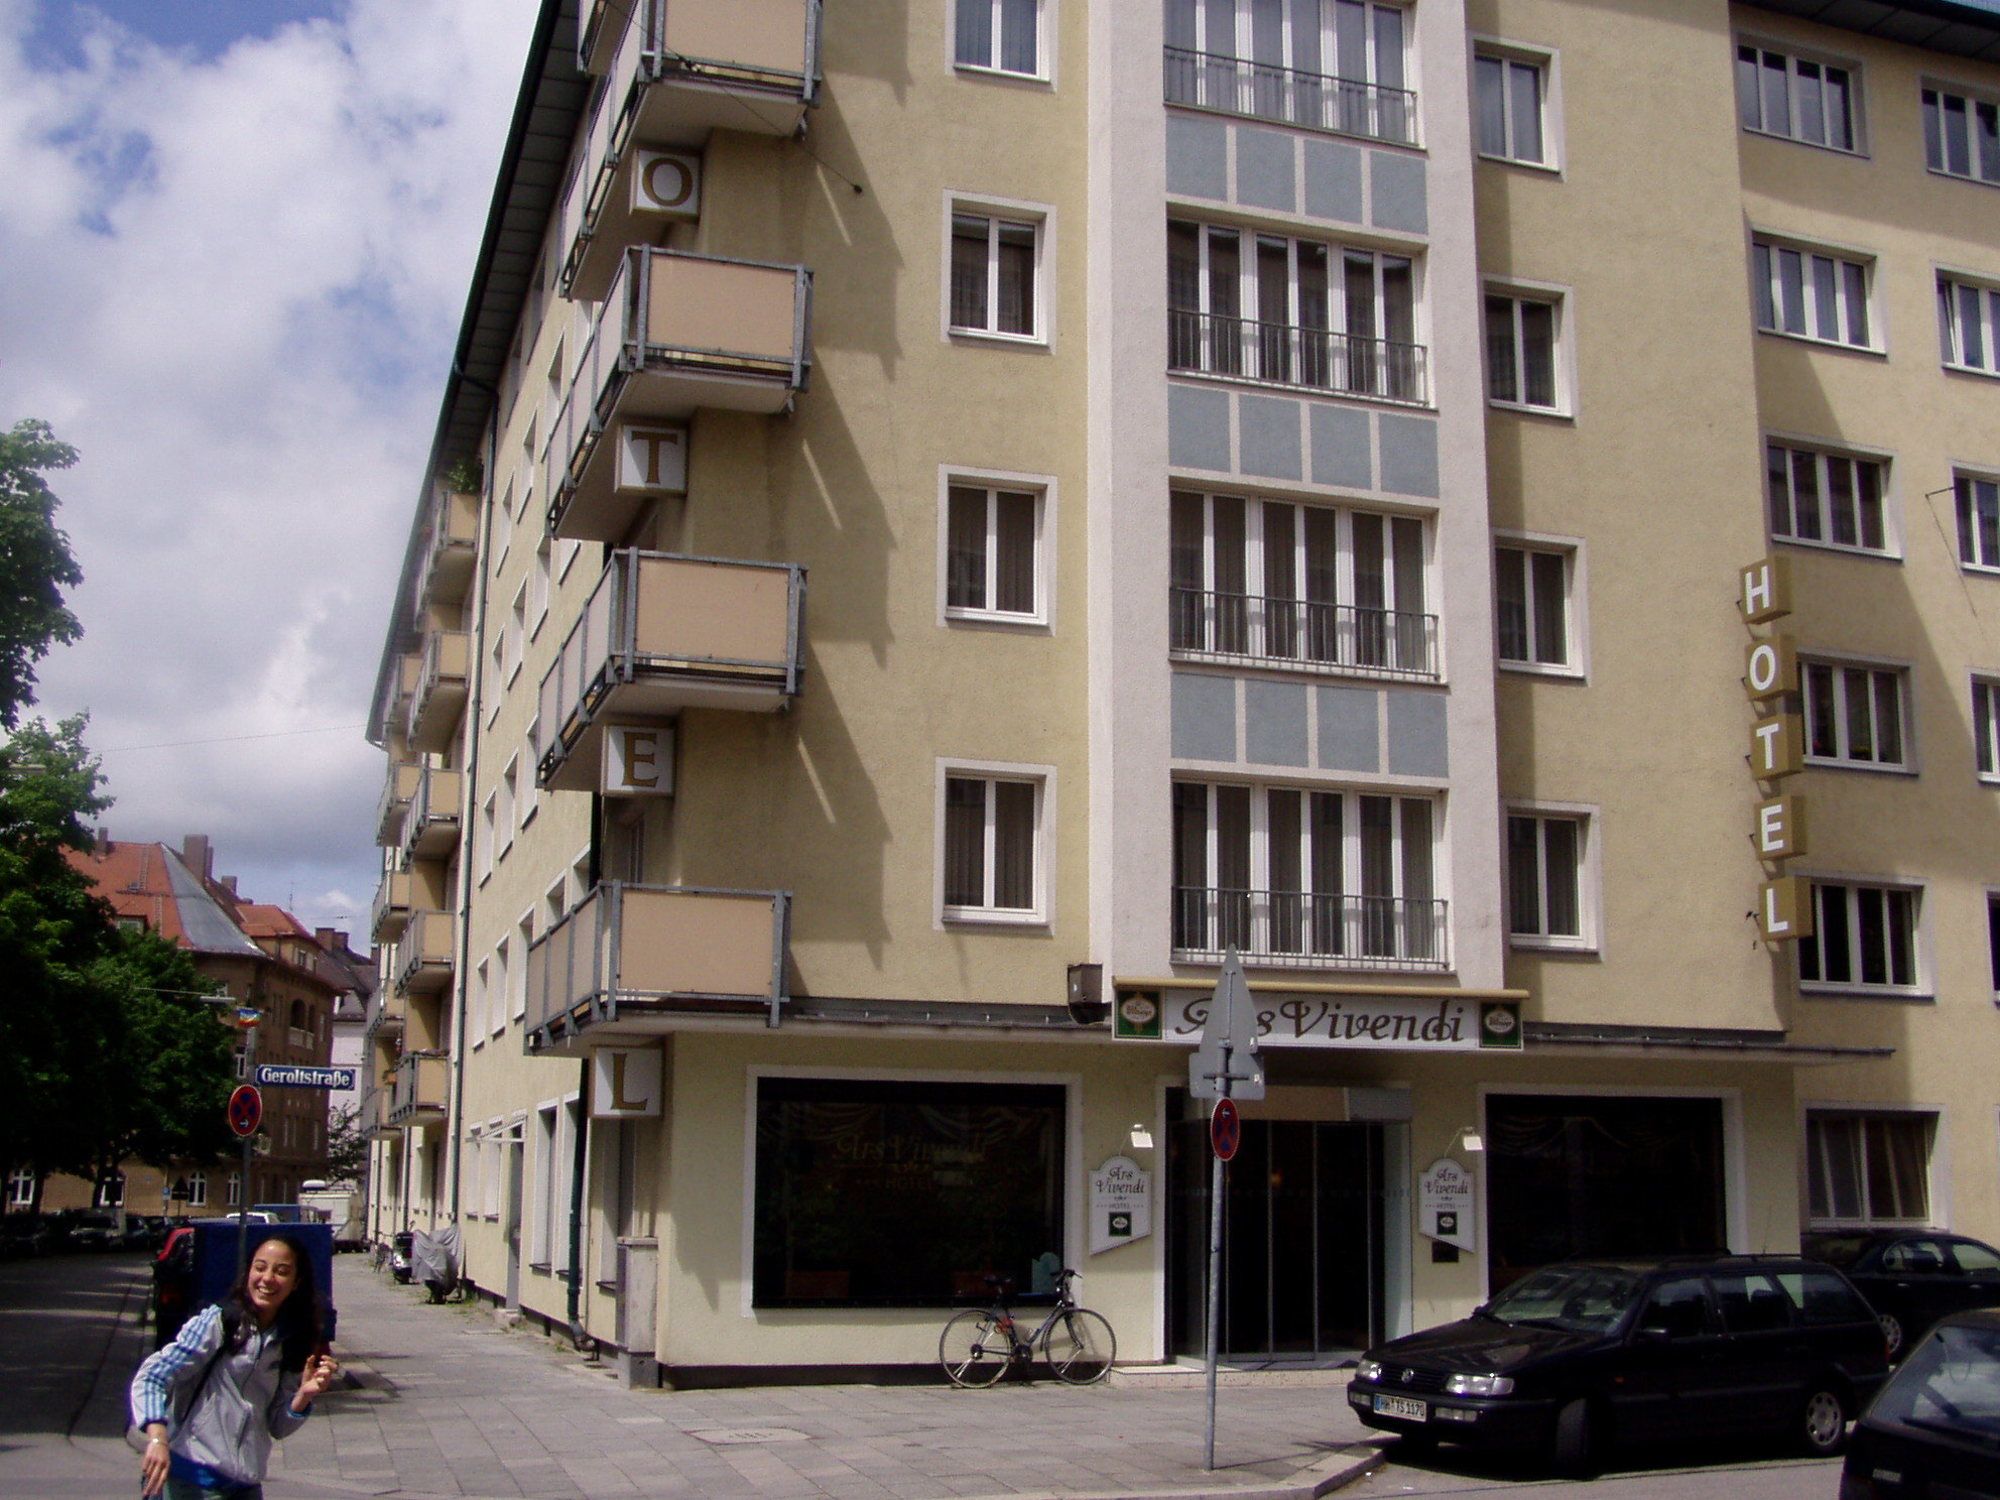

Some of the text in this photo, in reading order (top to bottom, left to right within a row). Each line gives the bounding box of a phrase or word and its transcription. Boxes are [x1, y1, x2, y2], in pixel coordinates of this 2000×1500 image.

[1744, 565, 1789, 933] HOTEL
[1280, 1000, 1465, 1042] Vivendi
[261, 1067, 350, 1087] Geroltstraße
[1107, 1165, 1133, 1180] Ars
[1096, 1179, 1144, 1194] Vivendi
[1424, 1180, 1468, 1195] Vivendi
